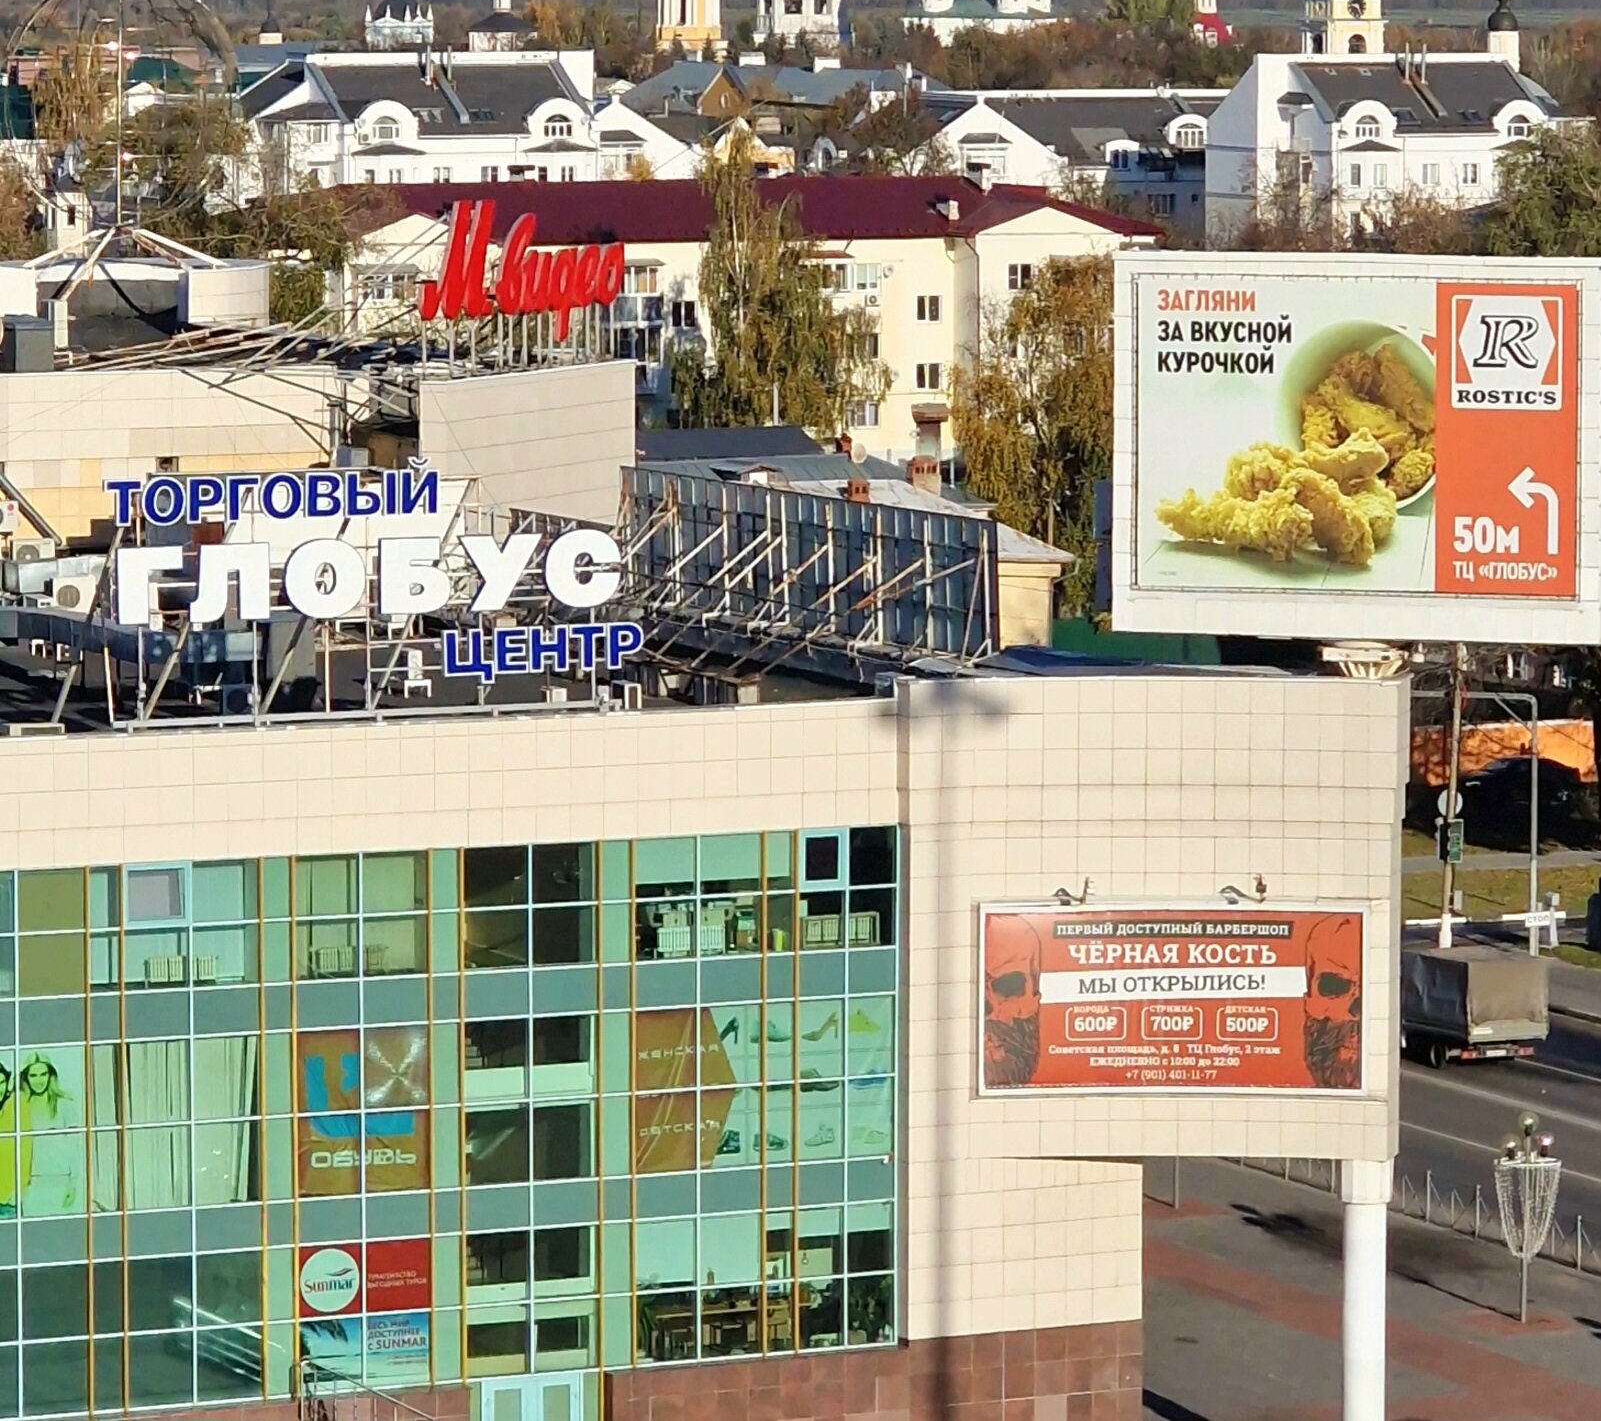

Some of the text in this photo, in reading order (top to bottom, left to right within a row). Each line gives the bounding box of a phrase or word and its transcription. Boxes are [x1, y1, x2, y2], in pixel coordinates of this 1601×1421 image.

[420, 199, 624, 341] М.видео
[1157, 289, 1256, 312] ЗАГЛЯНИ
[1157, 314, 1292, 343] ЗА ВКУСНОЙ
[1157, 345, 1274, 374] КУРОЧКОЙ
[1457, 389, 1557, 405] ROSTIC'S
[104, 457, 440, 527] ТОРГОВЫЙ
[115, 528, 622, 625] ГЛОБУС
[1453, 561, 1558, 582] ТЦ «ГЛОБУС»
[444, 622, 643, 684] ЦЕНТР
[1056, 922, 1290, 936] ПЕРВЫЙ ДОСТУПНЫЙ БАРБЕРШОП
[1068, 940, 1277, 964] ЧЁРНАЯ КОСТЬ
[1078, 974, 1266, 994] МЫ ОТКРЫЛИСЬ!
[1073, 1005, 1110, 1014] БОРОДА
[1149, 1005, 1194, 1013] СТРИЖКА
[1224, 1005, 1267, 1014] ДЕТСКАЯ
[638, 1044, 719, 1060] ЖЕНСКАЯ
[1048, 1044, 1105, 1054] Советская
[1186, 1043, 1203, 1055] ТЦ
[1245, 1044, 1252, 1054] 2
[1254, 1046, 1281, 1054] этаж
[1089, 1057, 1160, 1067] ЕЖЕДНЕВНО
[1170, 1057, 1196, 1066] 10:00
[1198, 1058, 1212, 1067] до
[1213, 1057, 1240, 1066] 22:00
[1125, 1069, 1139, 1080] +7
[1141, 1069, 1167, 1080] (901)
[639, 1120, 720, 1137] ДЕТСКАЯ
[310, 1148, 417, 1169] ОБУВЬ
[303, 1277, 356, 1294] Sunmar
[376, 1336, 427, 1350] SUNMAR
